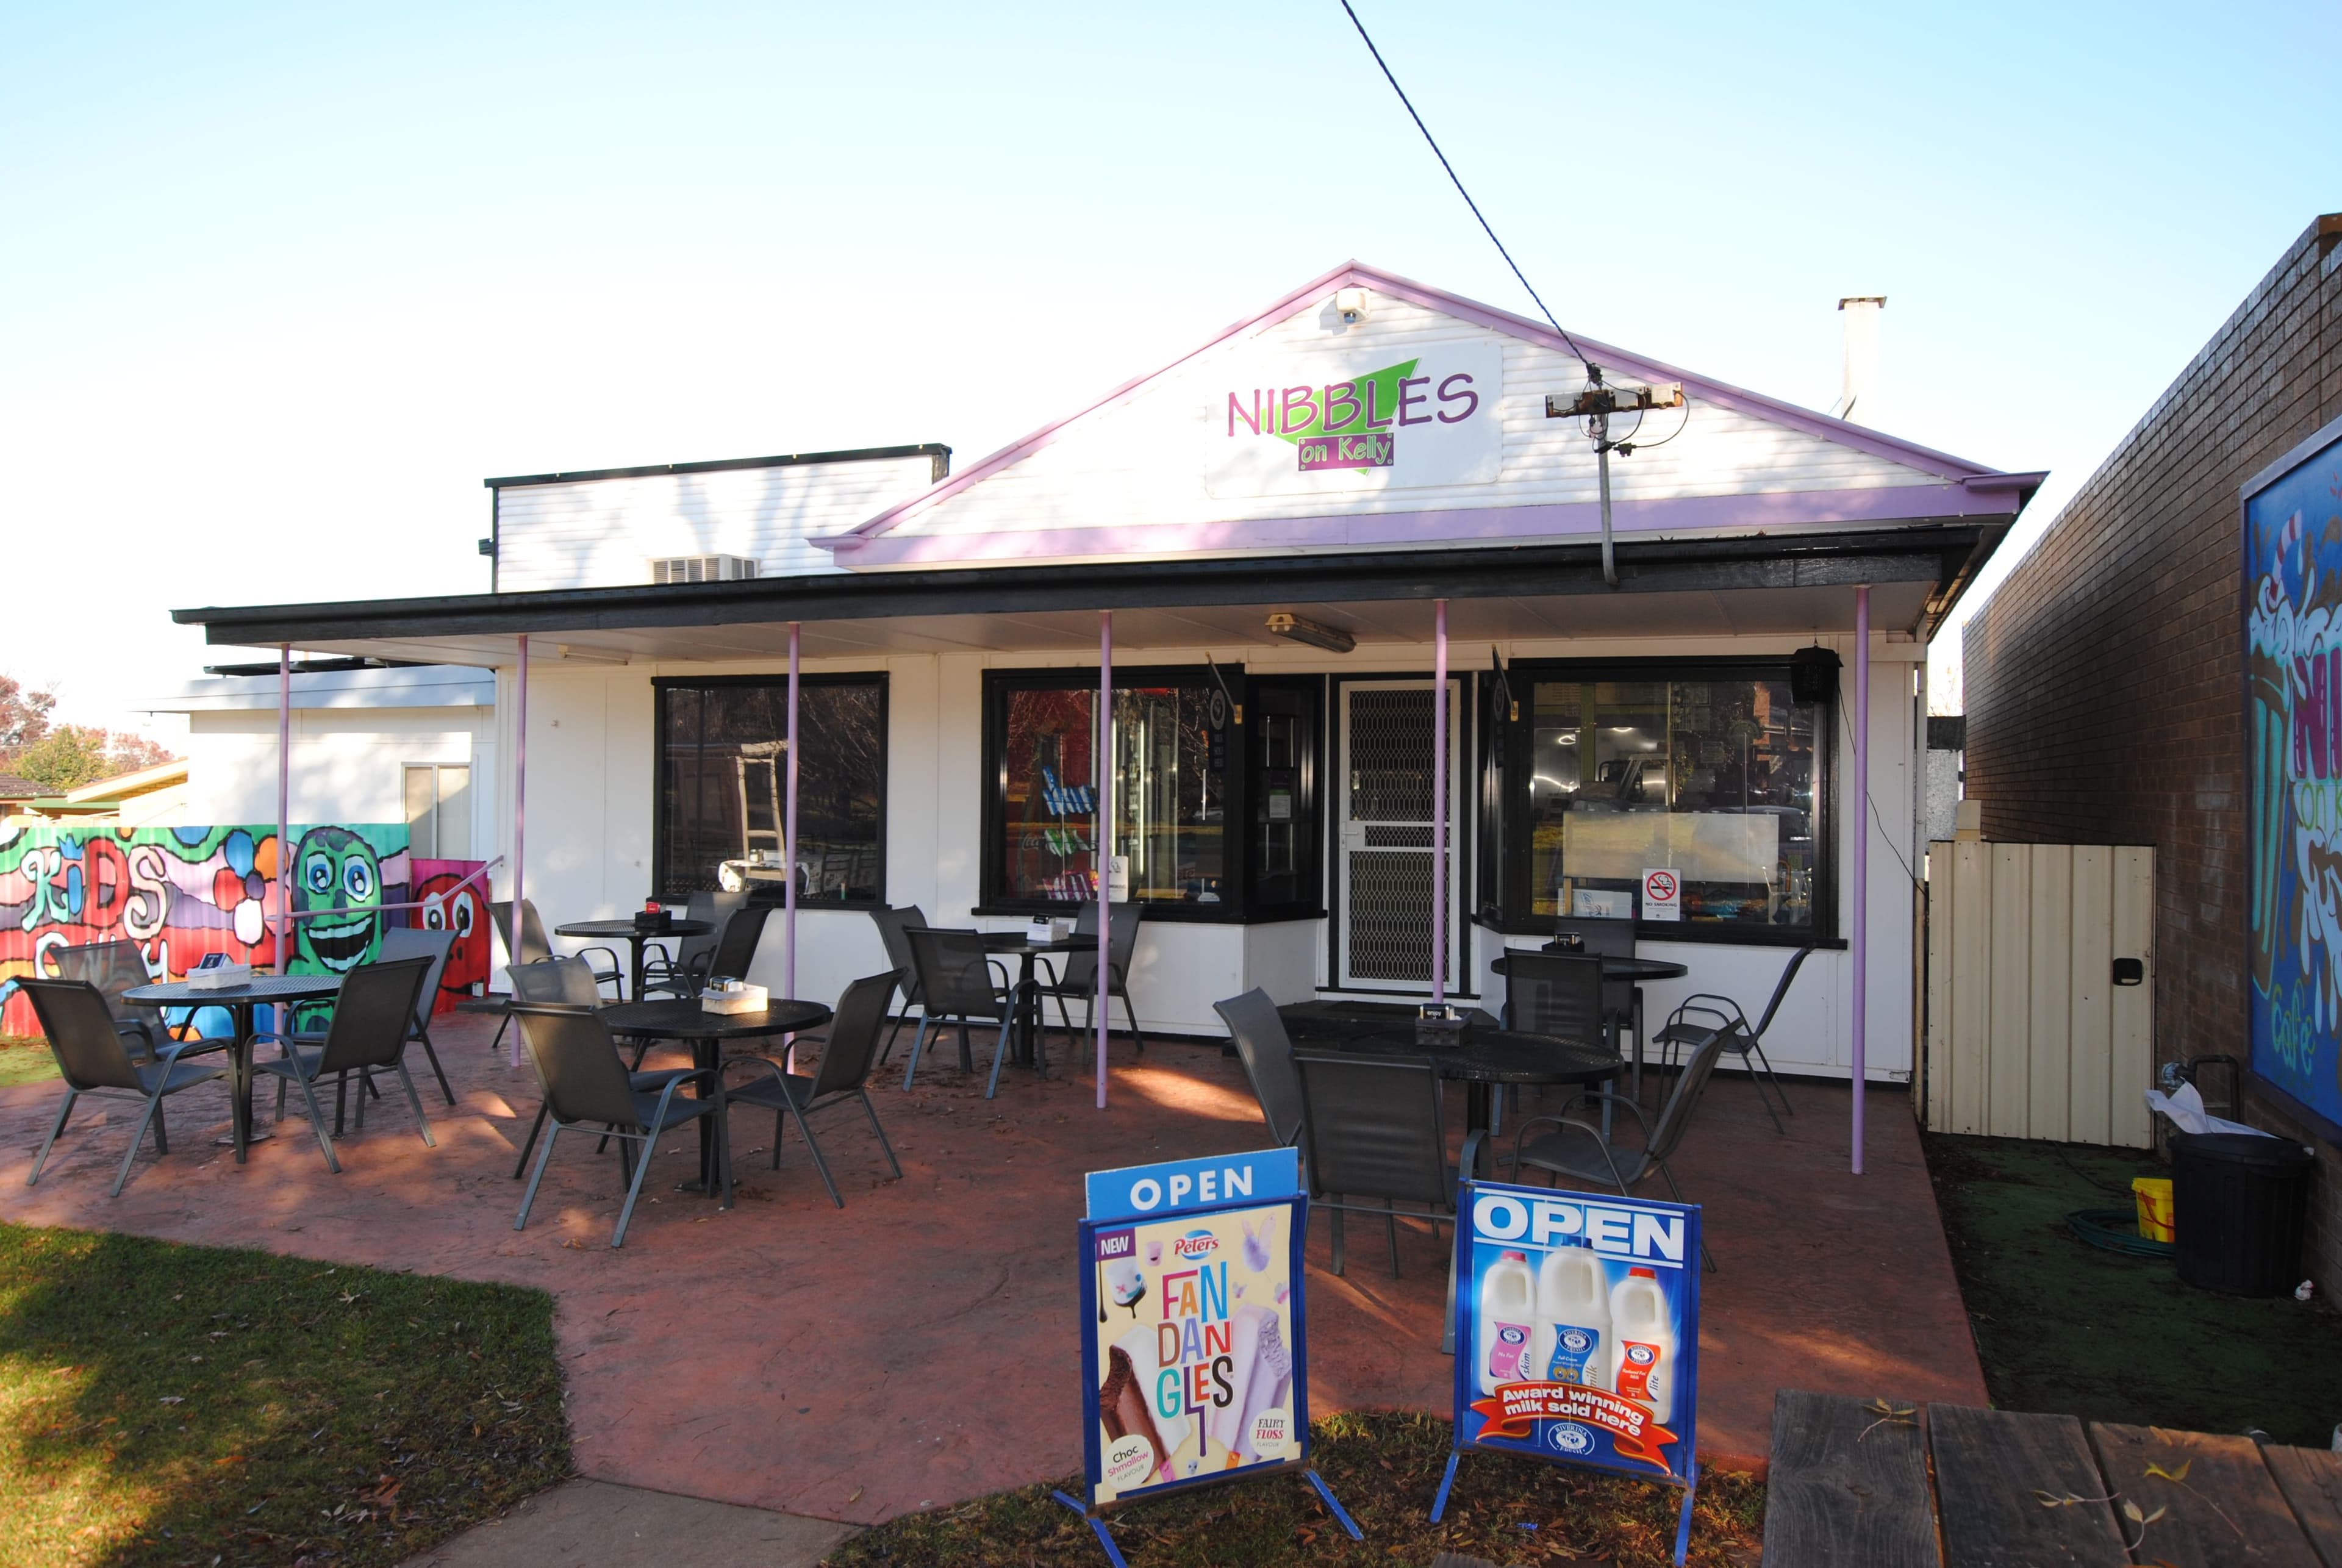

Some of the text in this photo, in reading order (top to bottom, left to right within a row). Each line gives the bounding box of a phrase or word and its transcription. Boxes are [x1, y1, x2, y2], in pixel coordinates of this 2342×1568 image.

[1228, 373, 1478, 437] NIBBLES
[1301, 436, 1390, 464] on Kelly
[1130, 1165, 1253, 1211] OPEN
[1473, 1195, 1685, 1261] OPEN
[1101, 1236, 1129, 1256] NEW
[1174, 1237, 1219, 1255] Peters
[1520, 1353, 1530, 1374] skim
[1649, 1375, 1659, 1391] lite
[1503, 1387, 1644, 1425] Award winning
[1259, 1419, 1285, 1428] FAIRY
[1505, 1400, 1641, 1436] milk sold here
[1256, 1429, 1284, 1439] FLOSS
[1555, 1425, 1588, 1437] RIVERINA
[1108, 1451, 1149, 1477] Shmallow
[1113, 1445, 1139, 1463] Choc
[1117, 1464, 1144, 1482] FLAVOUR
